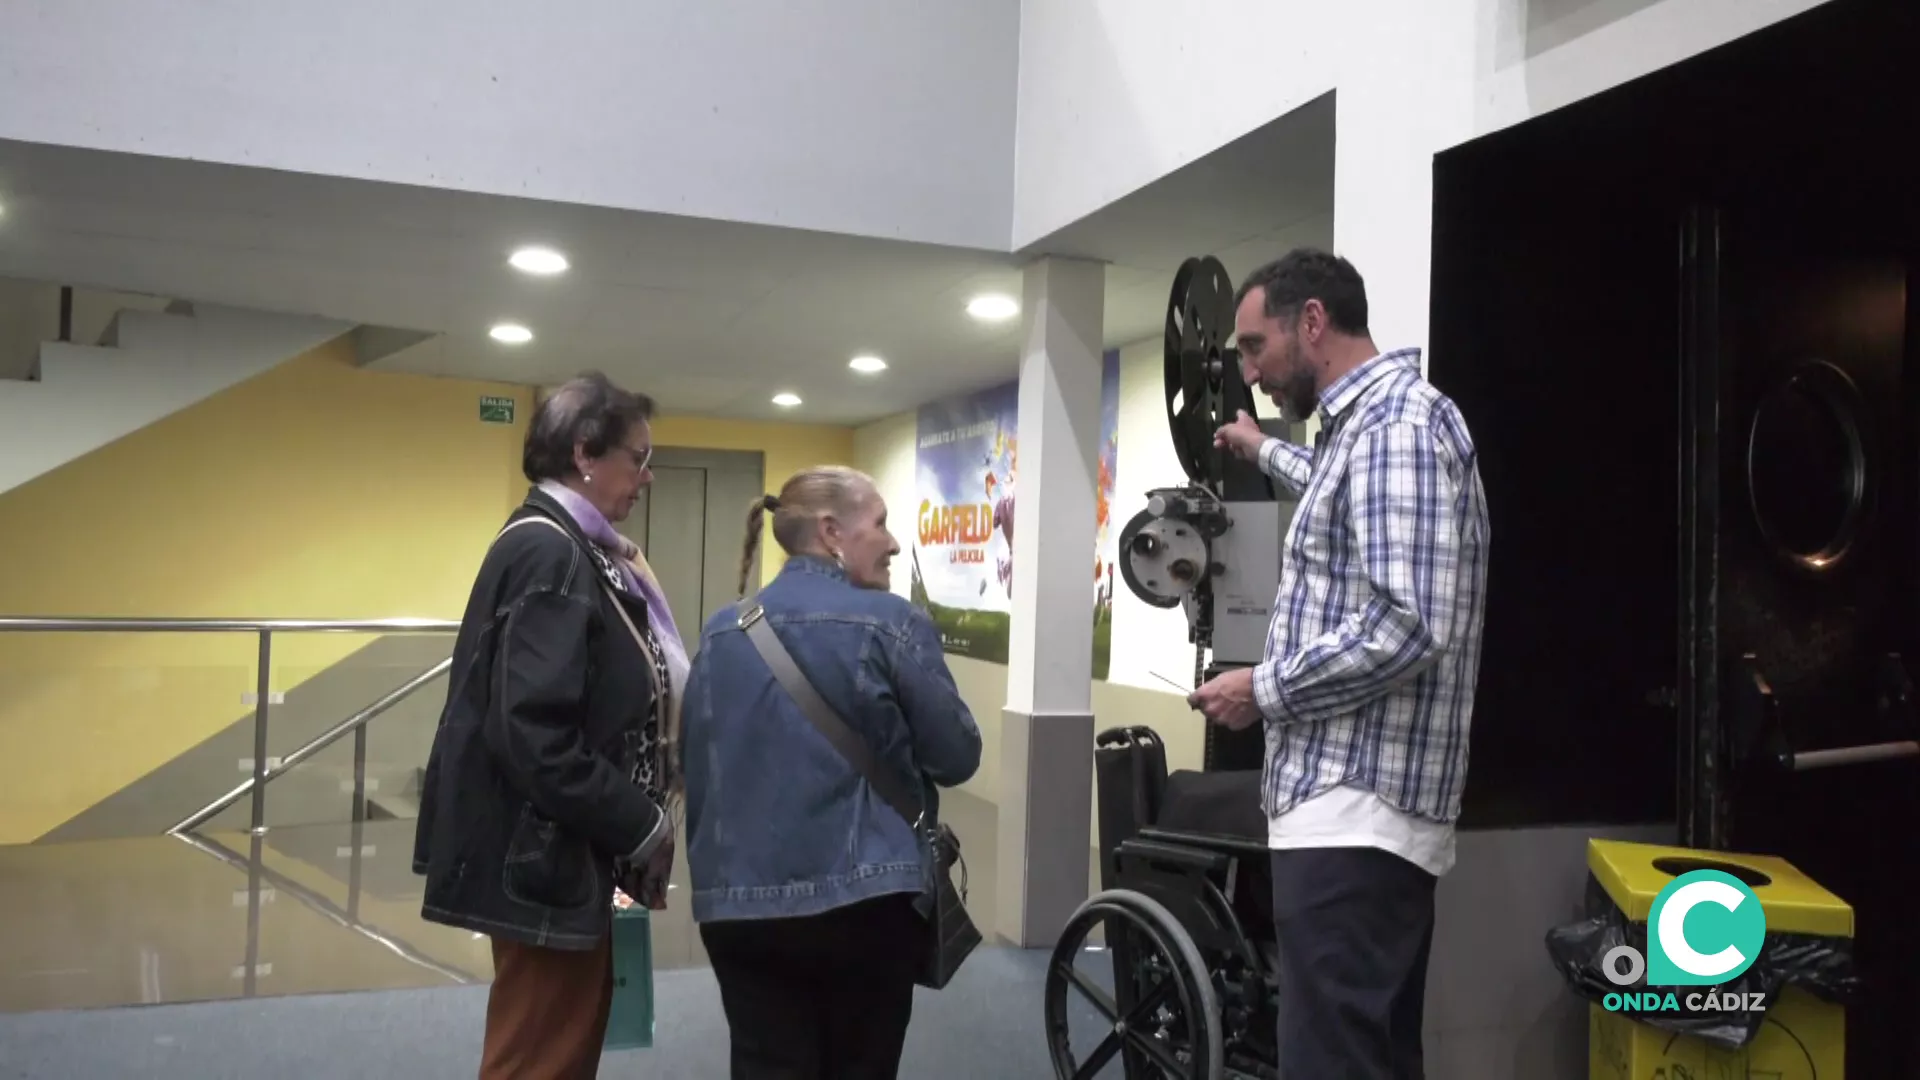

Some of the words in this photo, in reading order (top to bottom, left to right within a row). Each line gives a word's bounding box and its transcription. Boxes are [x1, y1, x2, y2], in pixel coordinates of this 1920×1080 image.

[480, 397, 513, 406] SALIDA
[918, 498, 993, 547] GARFIELD
[950, 550, 957, 564] LA
